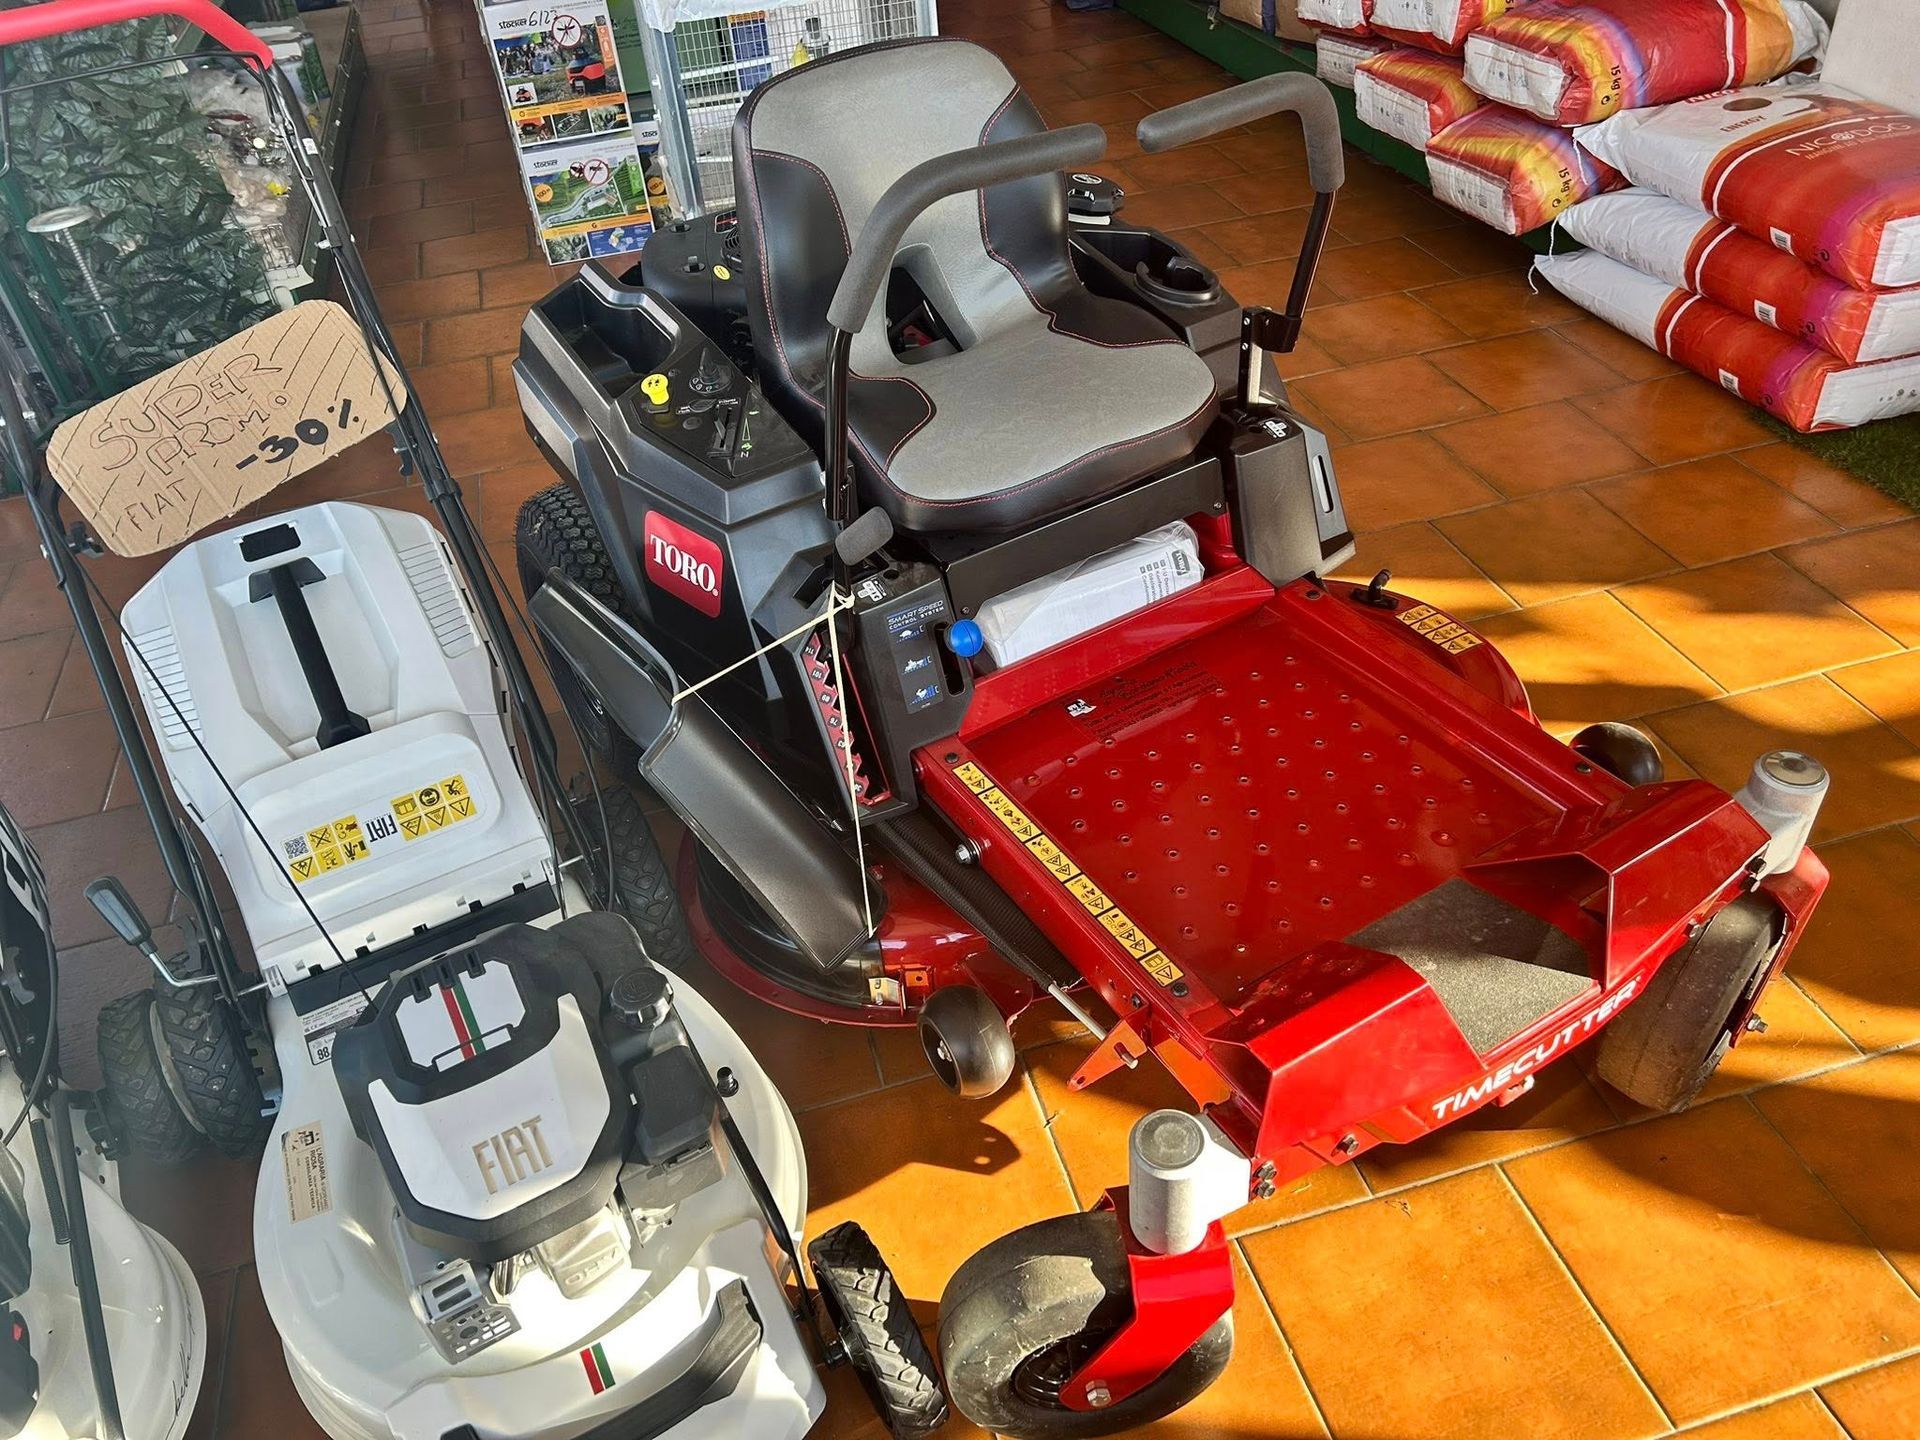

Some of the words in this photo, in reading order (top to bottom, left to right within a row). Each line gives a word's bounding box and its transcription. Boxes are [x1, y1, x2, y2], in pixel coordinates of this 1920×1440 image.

[1610, 65, 1620, 76] 15
[1610, 77, 1620, 91] kg
[1720, 115, 1768, 133] ENERGY
[1558, 167, 1569, 180] 15
[1560, 181, 1570, 194] kg
[89, 353, 283, 471] SUPER
[124, 478, 187, 531] FIAT
[650, 533, 717, 595] TORO
[888, 609, 917, 625] SMART
[917, 600, 944, 614] SPEED
[888, 617, 917, 631] CONTROL
[920, 606, 945, 619] SYSTEM
[365, 814, 398, 843] FIAT
[317, 1046, 330, 1061] 98
[1431, 980, 1638, 1120] TIMECUTTER
[310, 1149, 318, 1171] RIOSA
[472, 1114, 554, 1195] FIAT
